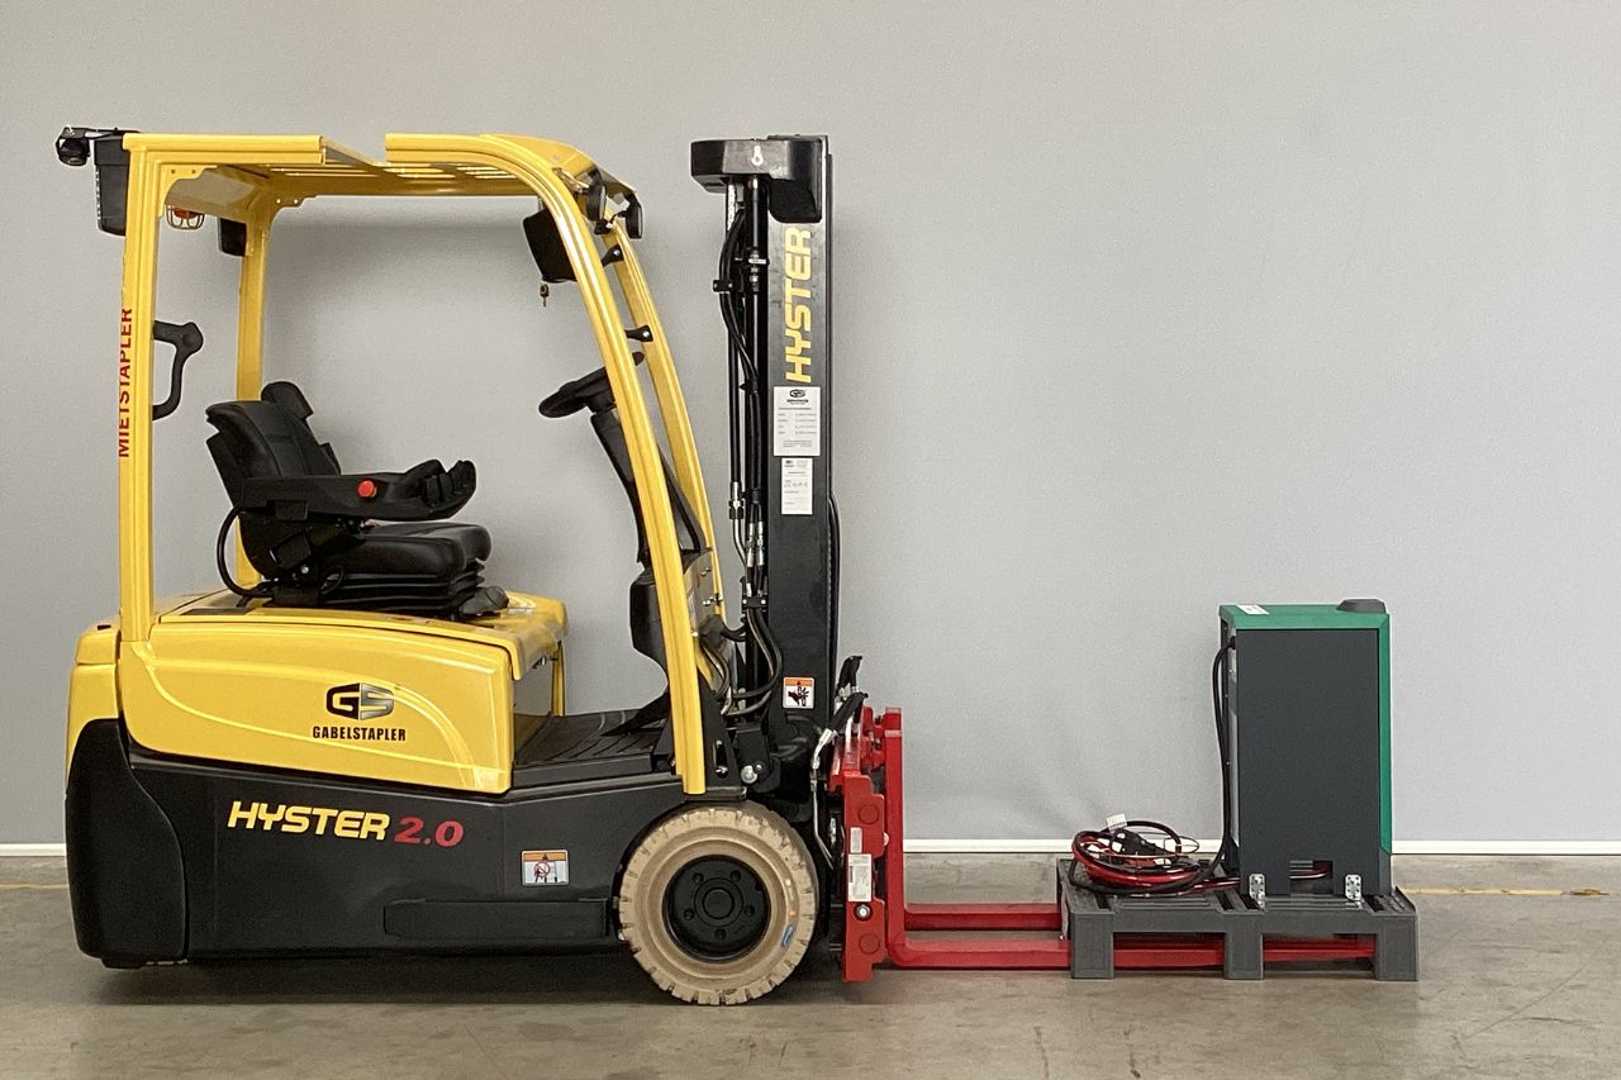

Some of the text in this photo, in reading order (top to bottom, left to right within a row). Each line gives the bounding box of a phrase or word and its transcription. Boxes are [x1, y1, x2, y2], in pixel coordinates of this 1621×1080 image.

[784, 227, 812, 383] HYSTER
[118, 308, 132, 458] MIETSTAPLER
[326, 682, 394, 720] GS
[312, 726, 406, 741] GABELSTAPLER
[227, 801, 464, 847] HYSTER 2.0
